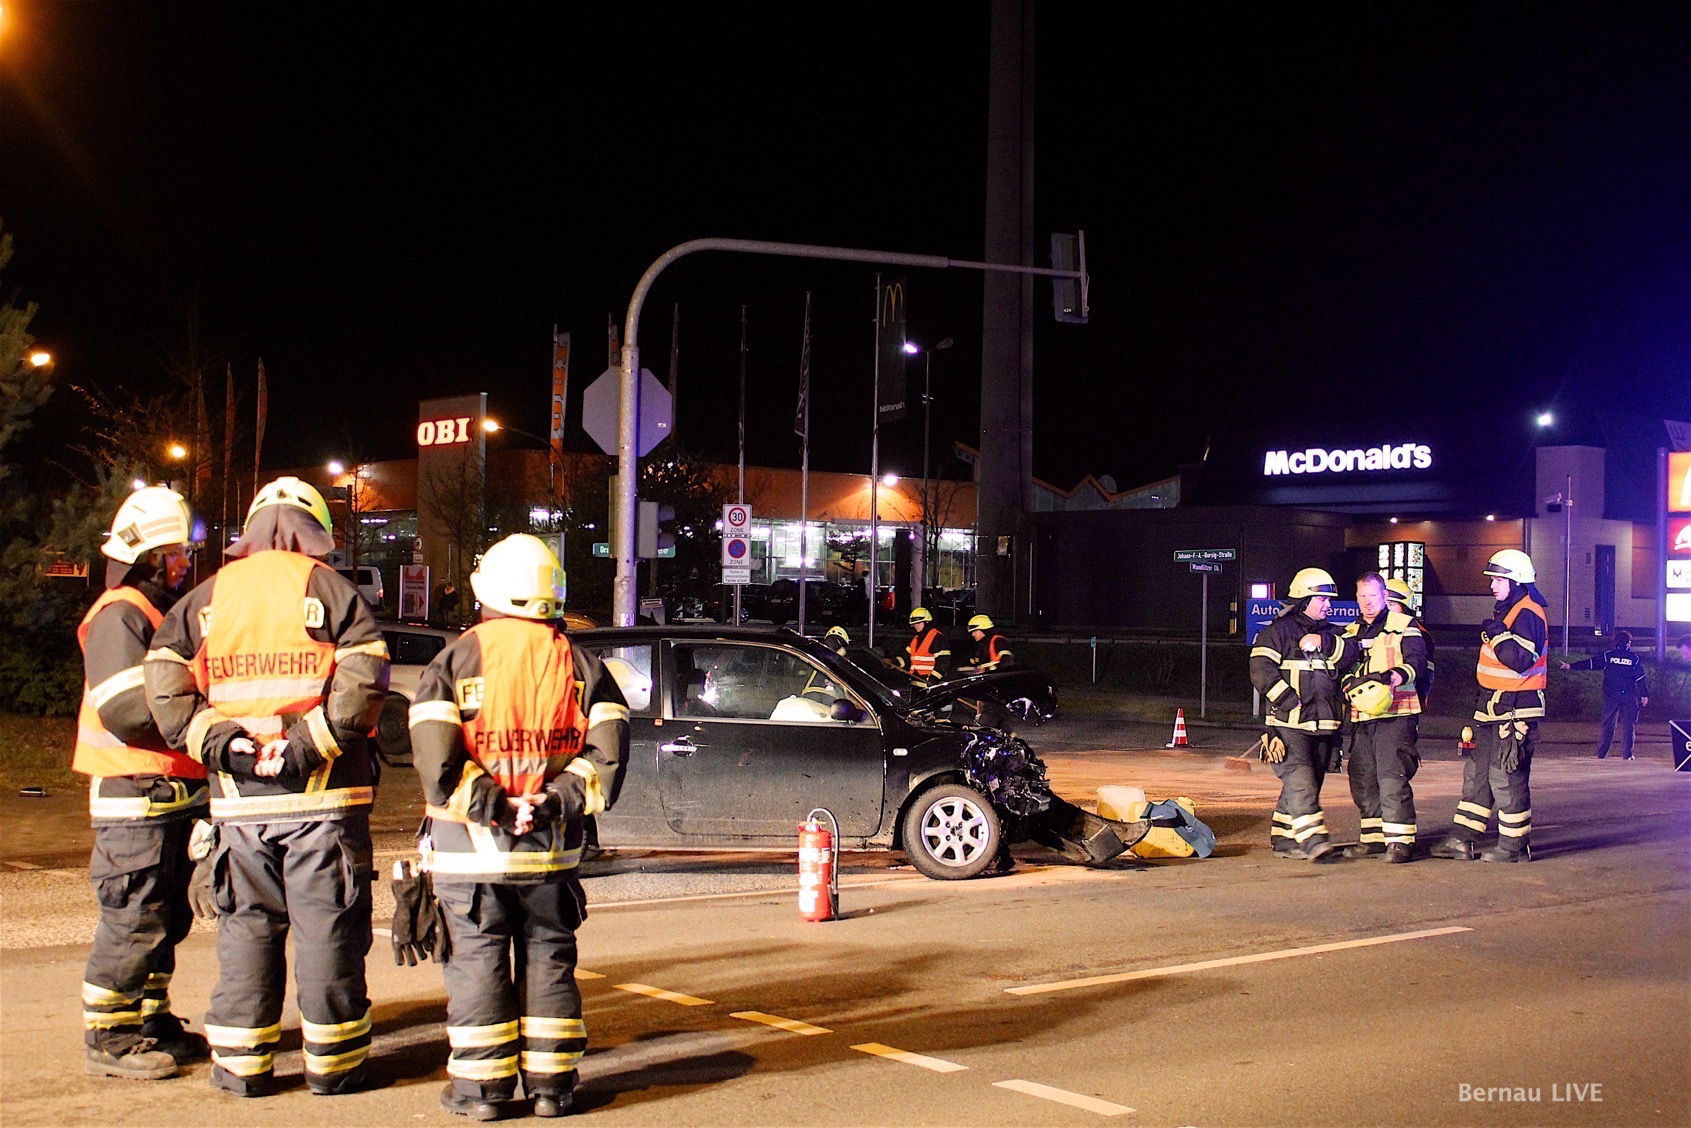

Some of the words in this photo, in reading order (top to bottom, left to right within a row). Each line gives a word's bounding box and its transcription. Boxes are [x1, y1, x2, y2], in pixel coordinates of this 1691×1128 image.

[417, 418, 470, 446] OBI
[1264, 443, 1432, 475] McDonald's
[732, 512, 743, 522] 30
[1251, 603, 1280, 616] Auto
[1326, 607, 1360, 617] ernau
[204, 651, 318, 680] FEUERWEHR
[1610, 656, 1632, 666] POLIZEI
[474, 727, 582, 754] FEUERWEHR
